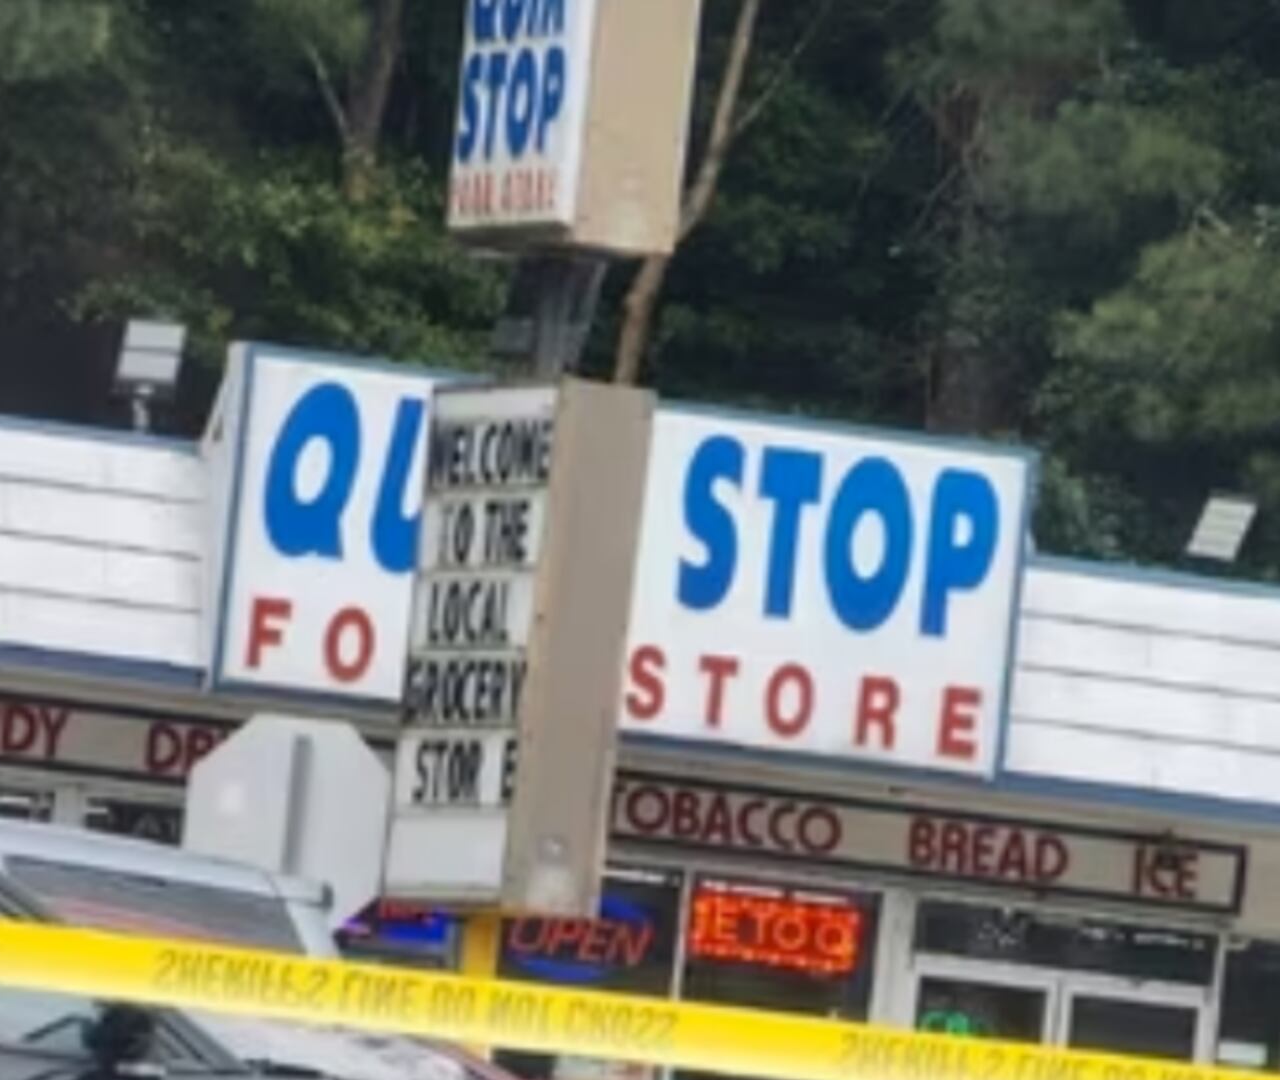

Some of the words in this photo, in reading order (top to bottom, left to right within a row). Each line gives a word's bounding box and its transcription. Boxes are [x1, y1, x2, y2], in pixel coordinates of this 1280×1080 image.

[456, 46, 565, 163] STOP
[429, 421, 552, 486] WELCOME
[485, 500, 529, 561] THE
[676, 434, 1001, 638] STOP
[427, 581, 508, 643] LOCAL
[403, 660, 528, 724] GROCERY
[626, 645, 983, 760] STORE
[609, 779, 842, 854] TOBACCO
[908, 816, 1070, 884] BREAD
[1132, 840, 1200, 899] ICE
[508, 913, 655, 967] OPEN
